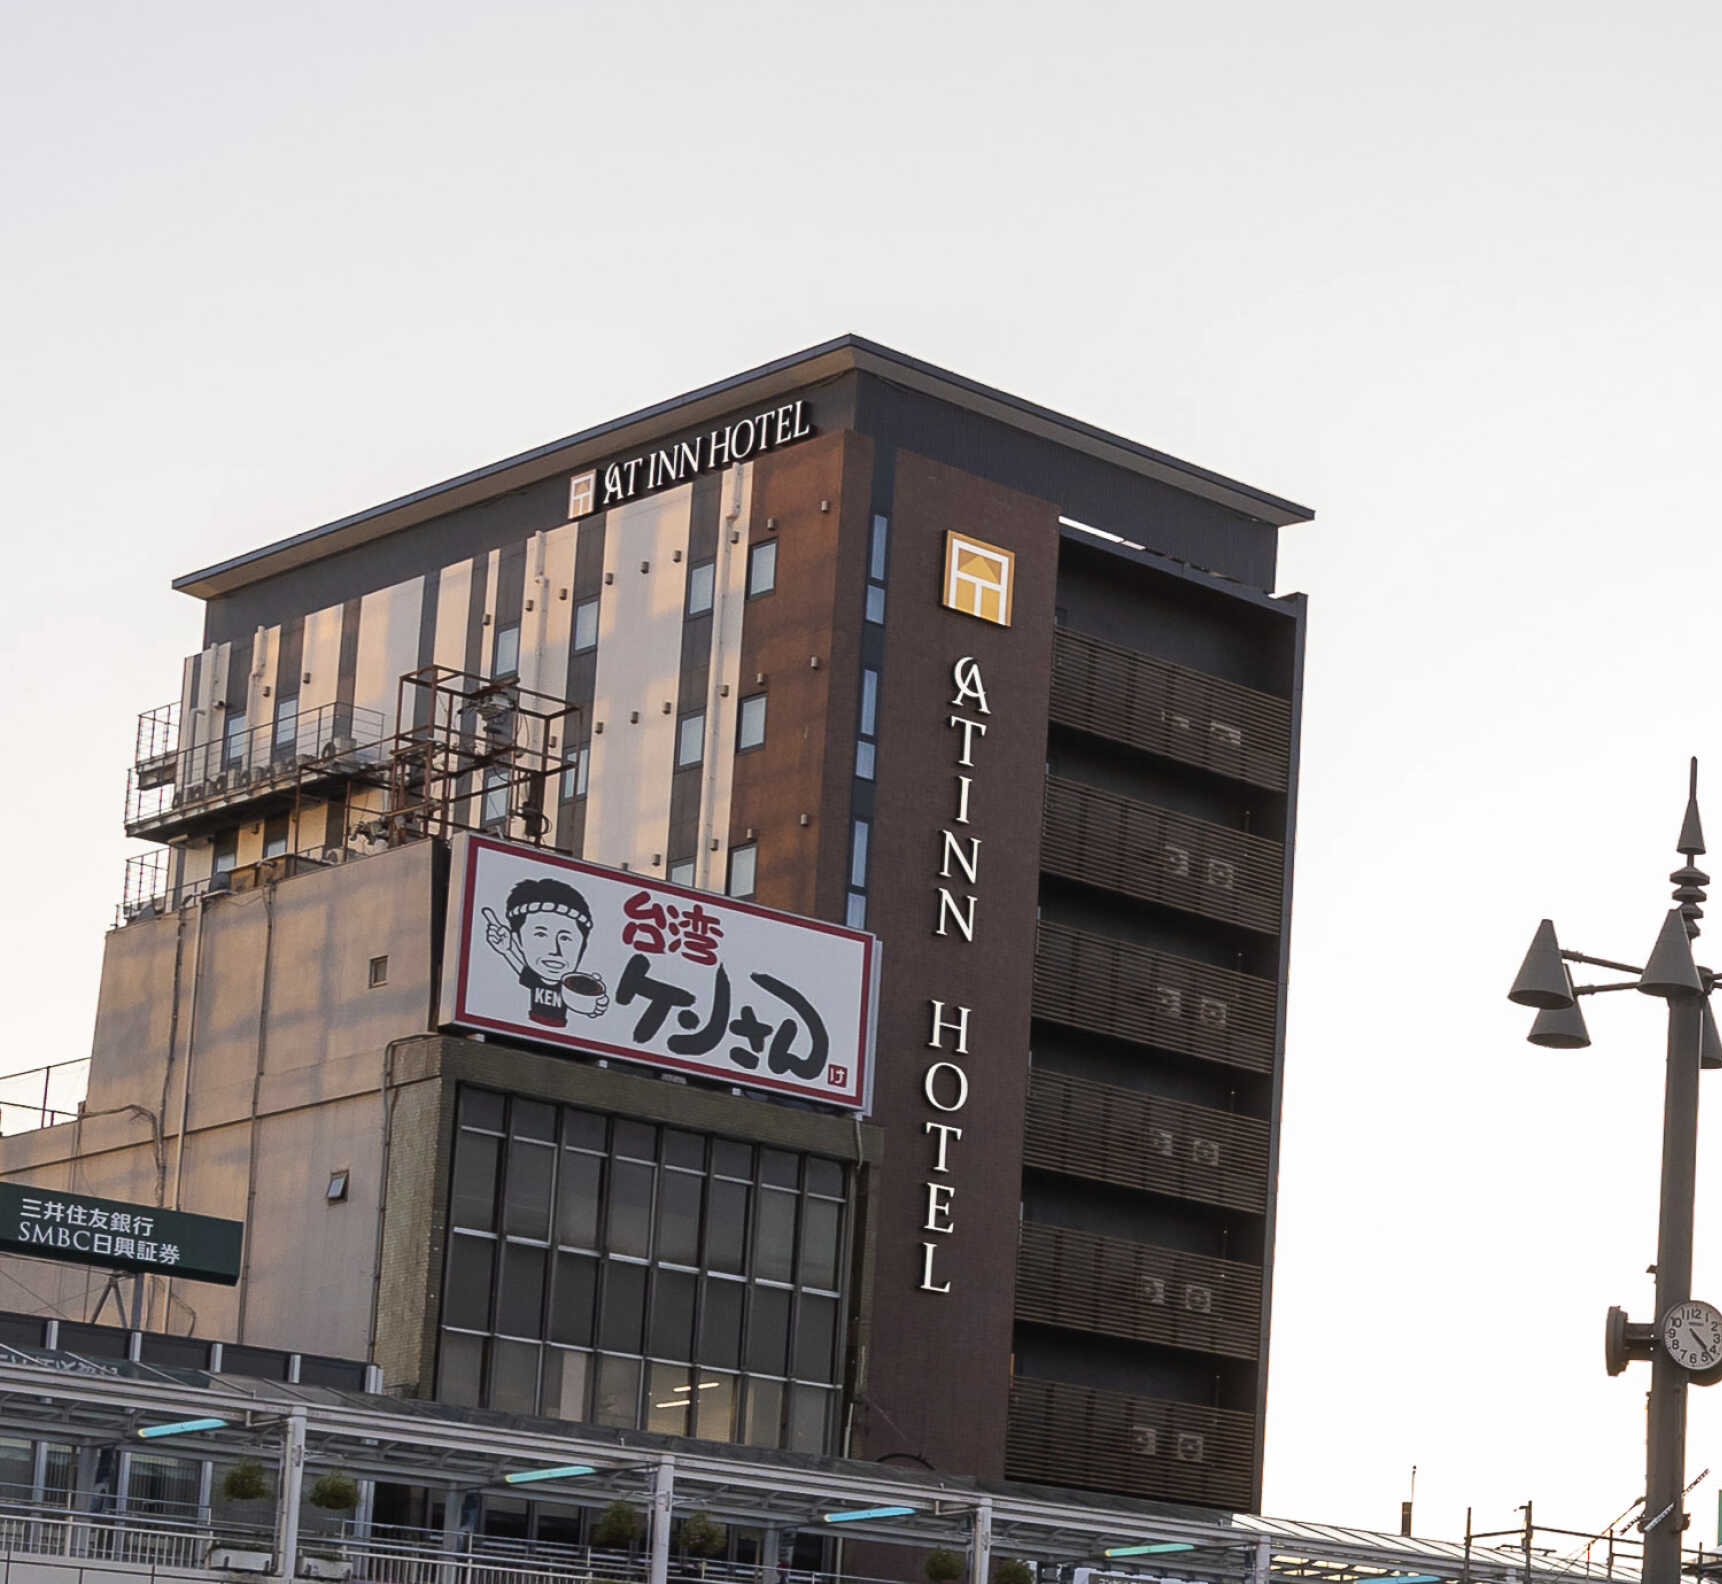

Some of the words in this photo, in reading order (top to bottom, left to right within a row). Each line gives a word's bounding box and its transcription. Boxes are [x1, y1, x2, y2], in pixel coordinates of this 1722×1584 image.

[648, 437, 702, 488] INN
[708, 400, 809, 468] HOTEL
[621, 891, 724, 966] 台湾
[615, 953, 830, 1081] ケンさん
[919, 999, 971, 1295] HOTEL
[18, 1221, 180, 1264] SMBC日興証券
[19, 1197, 154, 1237] 三井住友銀行
